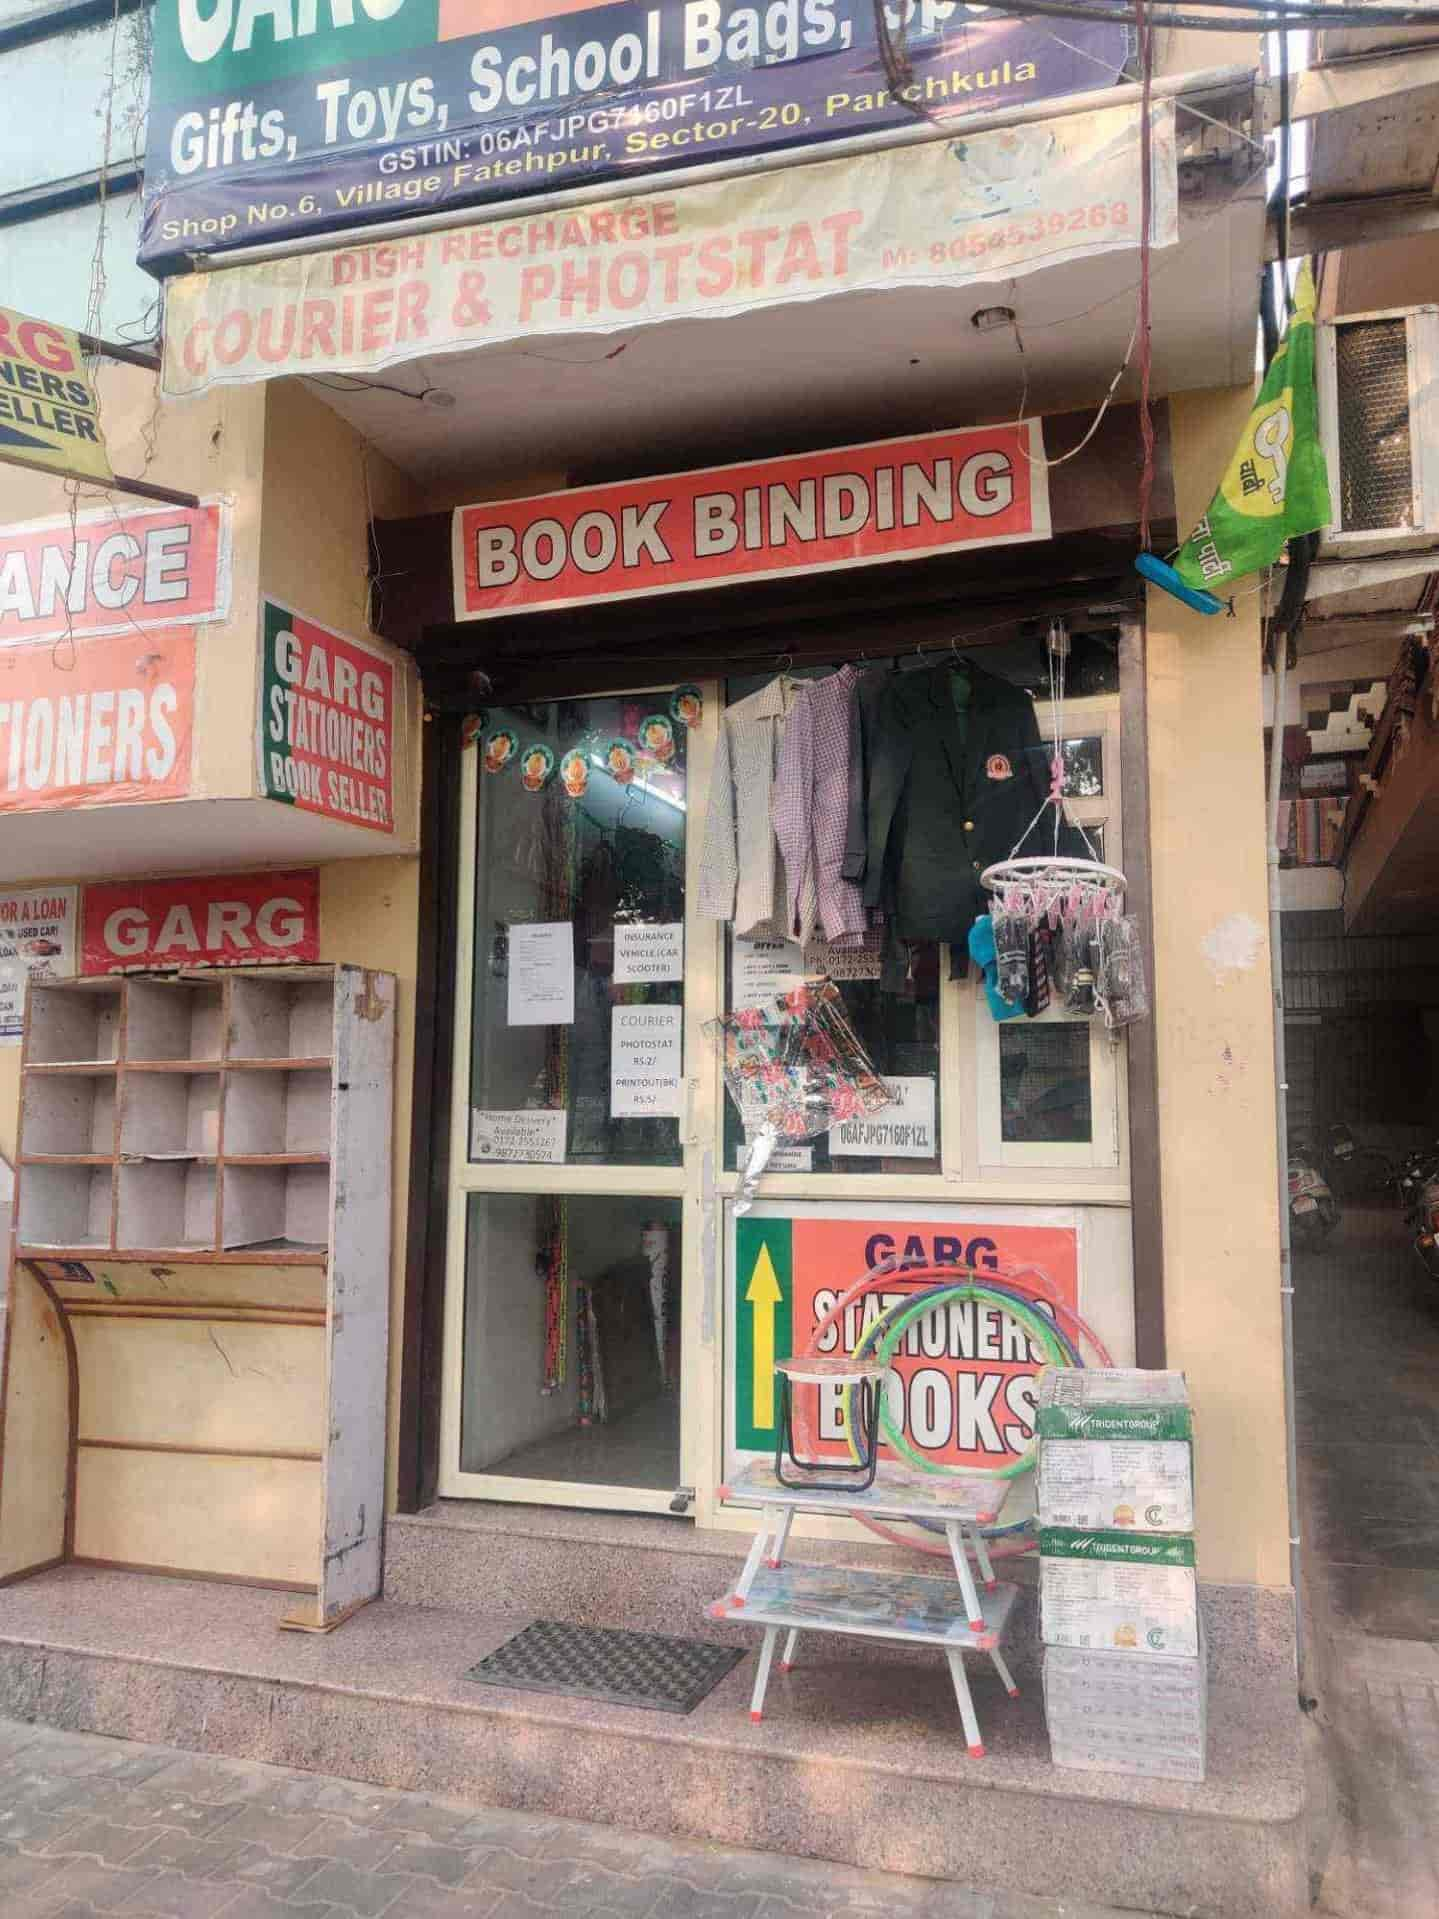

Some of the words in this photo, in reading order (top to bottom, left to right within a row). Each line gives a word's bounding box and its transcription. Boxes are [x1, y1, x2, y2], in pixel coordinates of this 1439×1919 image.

[170, 101, 298, 175] Gifts,
[316, 76, 449, 145] Toys,
[468, 11, 661, 113] School
[683, 0, 853, 71] Bags,
[161, 212, 238, 241] Shop
[247, 194, 323, 226] No.6,
[336, 172, 442, 209] Village
[454, 142, 612, 188] Fatehpur,
[625, 102, 812, 155] Sector-20,
[379, 138, 470, 174] GSTIN:
[332, 241, 425, 288] DISH
[441, 201, 679, 269] RECHARGE
[183, 280, 430, 377] COURIER
[452, 269, 494, 328] &
[518, 209, 865, 325] PHOTSTAT
[475, 498, 673, 590] BOOK
[693, 450, 1015, 559] BINDING
[0, 524, 192, 621] ANCE
[275, 629, 385, 722] GARG
[269, 684, 386, 780] STATIONERS
[270, 752, 323, 805] BOOK
[328, 770, 388, 825] SELLER
[33, 899, 66, 920] LOAN
[103, 897, 305, 956] GARG
[620, 1016, 673, 1026] COURIER
[620, 1040, 673, 1049] PHOTOSTAT
[865, 1233, 998, 1275] GARG
